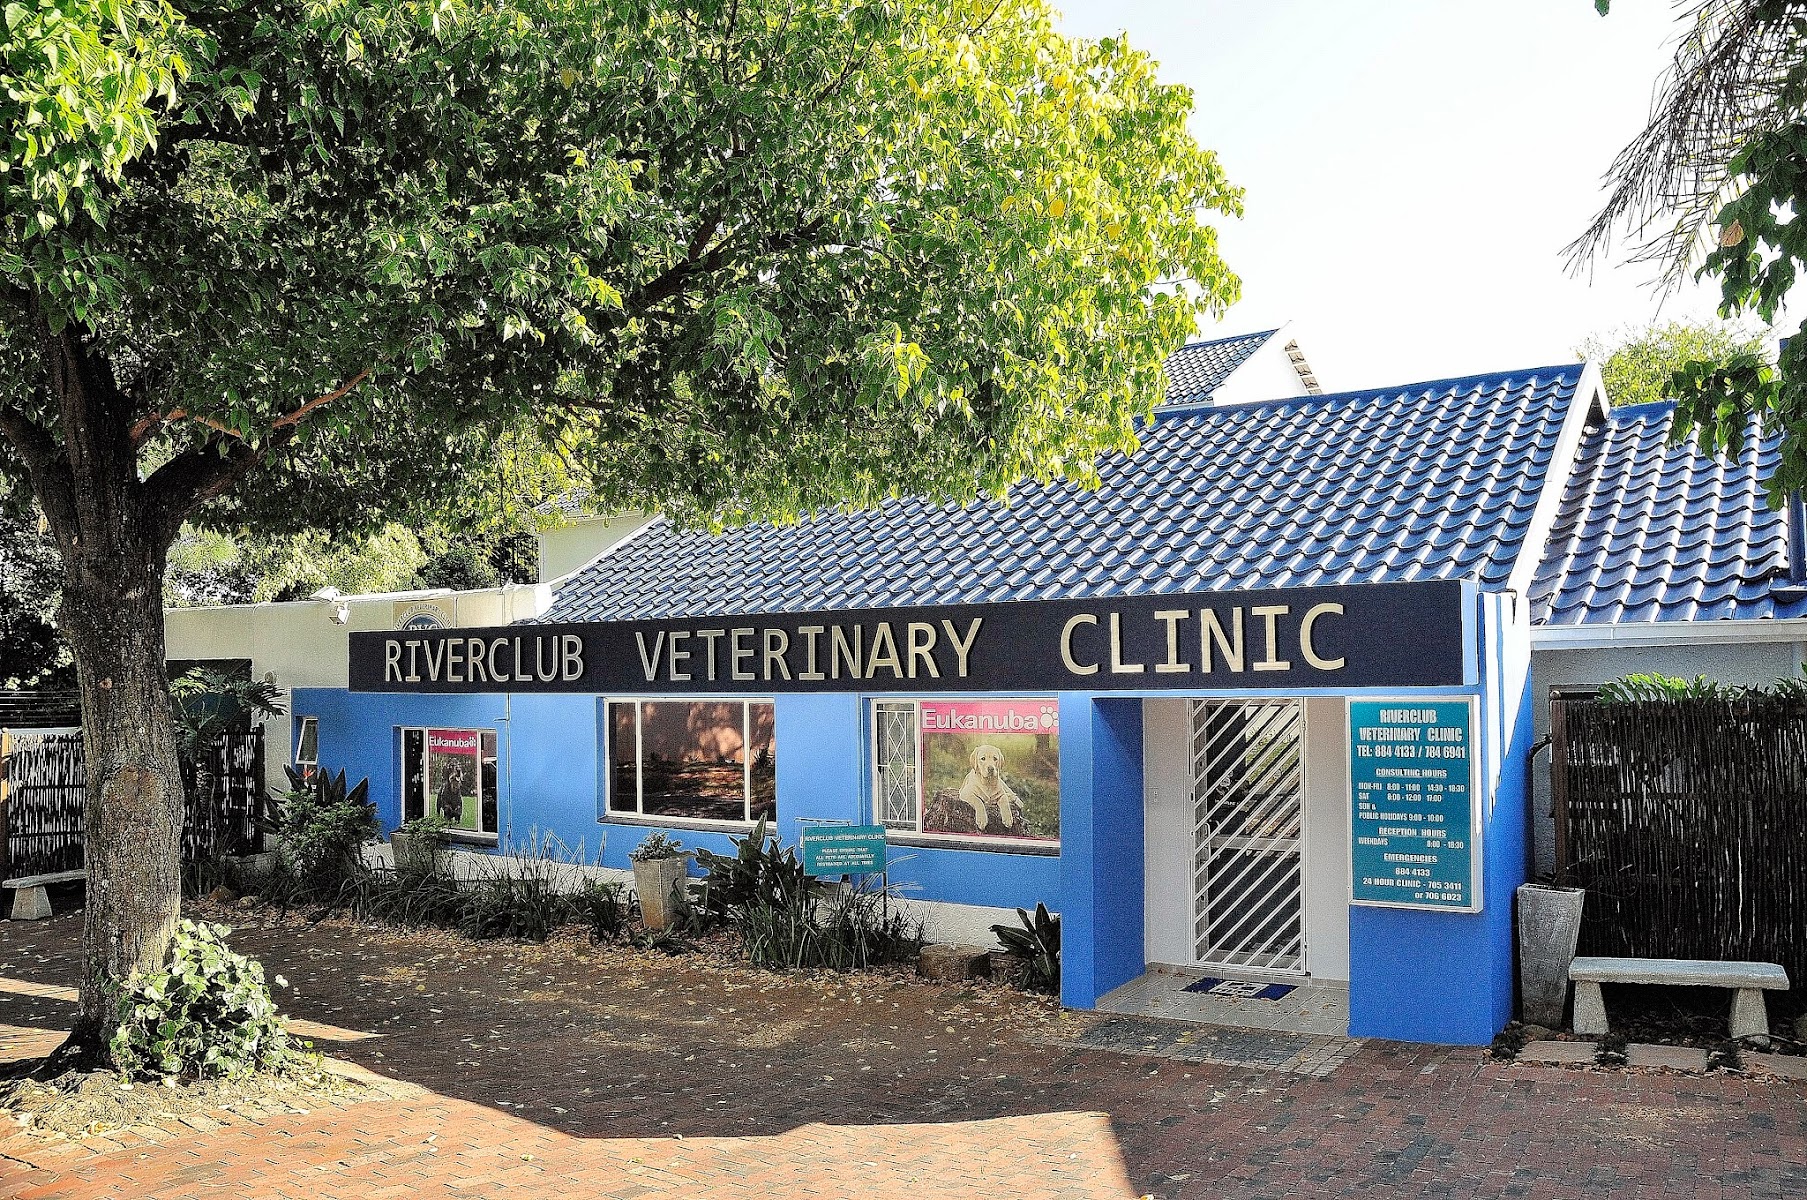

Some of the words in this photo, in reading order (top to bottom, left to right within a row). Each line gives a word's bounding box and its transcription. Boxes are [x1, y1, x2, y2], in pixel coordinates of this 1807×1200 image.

[385, 635, 584, 682] RIVERCLUB
[635, 617, 983, 681] VETERINARY
[1060, 602, 1345, 675] CLINIC
[921, 708, 1039, 730] Eukanuba
[1379, 709, 1437, 724] RIVERCLUB
[1359, 727, 1421, 741] VETERINARY
[1427, 727, 1463, 742] CLINIC
[429, 736, 469, 748] Eukanuba
[1356, 745, 1373, 757] TEL:
[1375, 745, 1392, 758] 884
[1394, 745, 1415, 758] 4133
[1443, 746, 1465, 758] 6941
[1375, 768, 1420, 777] CONSULTING
[1422, 769, 1447, 778] HOURS
[1358, 782, 1382, 791] MON-FRI
[1358, 792, 1369, 800] SAT
[1359, 812, 1379, 820] PUBLIC
[1380, 812, 1408, 821] HOLIDAYS
[1378, 827, 1417, 836] RECEPTION
[1421, 829, 1446, 838] HOURS
[1358, 837, 1388, 845] WEEKDAYS
[1383, 853, 1438, 863] EMERGENCIES
[1411, 868, 1430, 877] 4133
[1362, 877, 1372, 885] 24
[1374, 878, 1394, 887] HOUR
[1396, 880, 1421, 888] CLINIC
[1428, 881, 1442, 889] 705
[1444, 882, 1461, 890] 3411
[1425, 891, 1439, 900] 706
